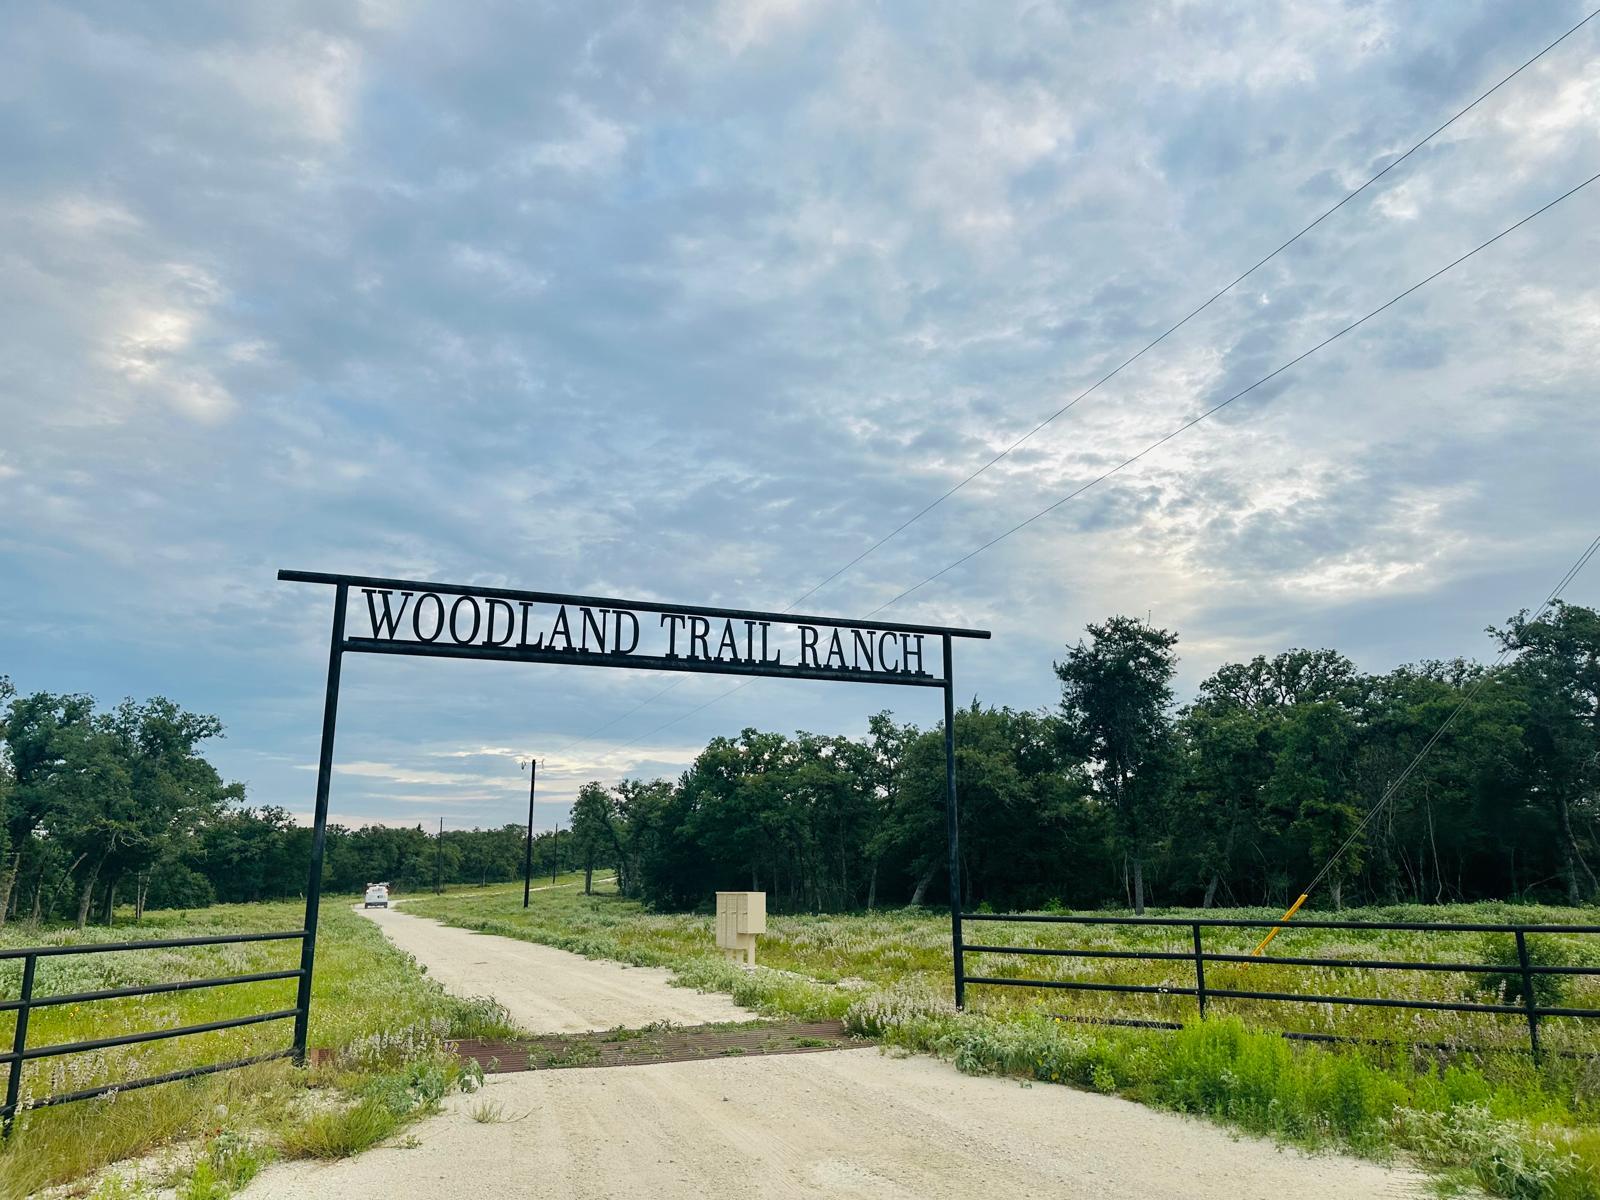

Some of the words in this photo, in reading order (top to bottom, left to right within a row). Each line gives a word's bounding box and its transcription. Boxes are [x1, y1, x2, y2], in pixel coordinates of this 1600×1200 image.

[361, 588, 640, 655] WOODLAND
[660, 613, 781, 666] TRAIL
[797, 625, 925, 676] RANCH
